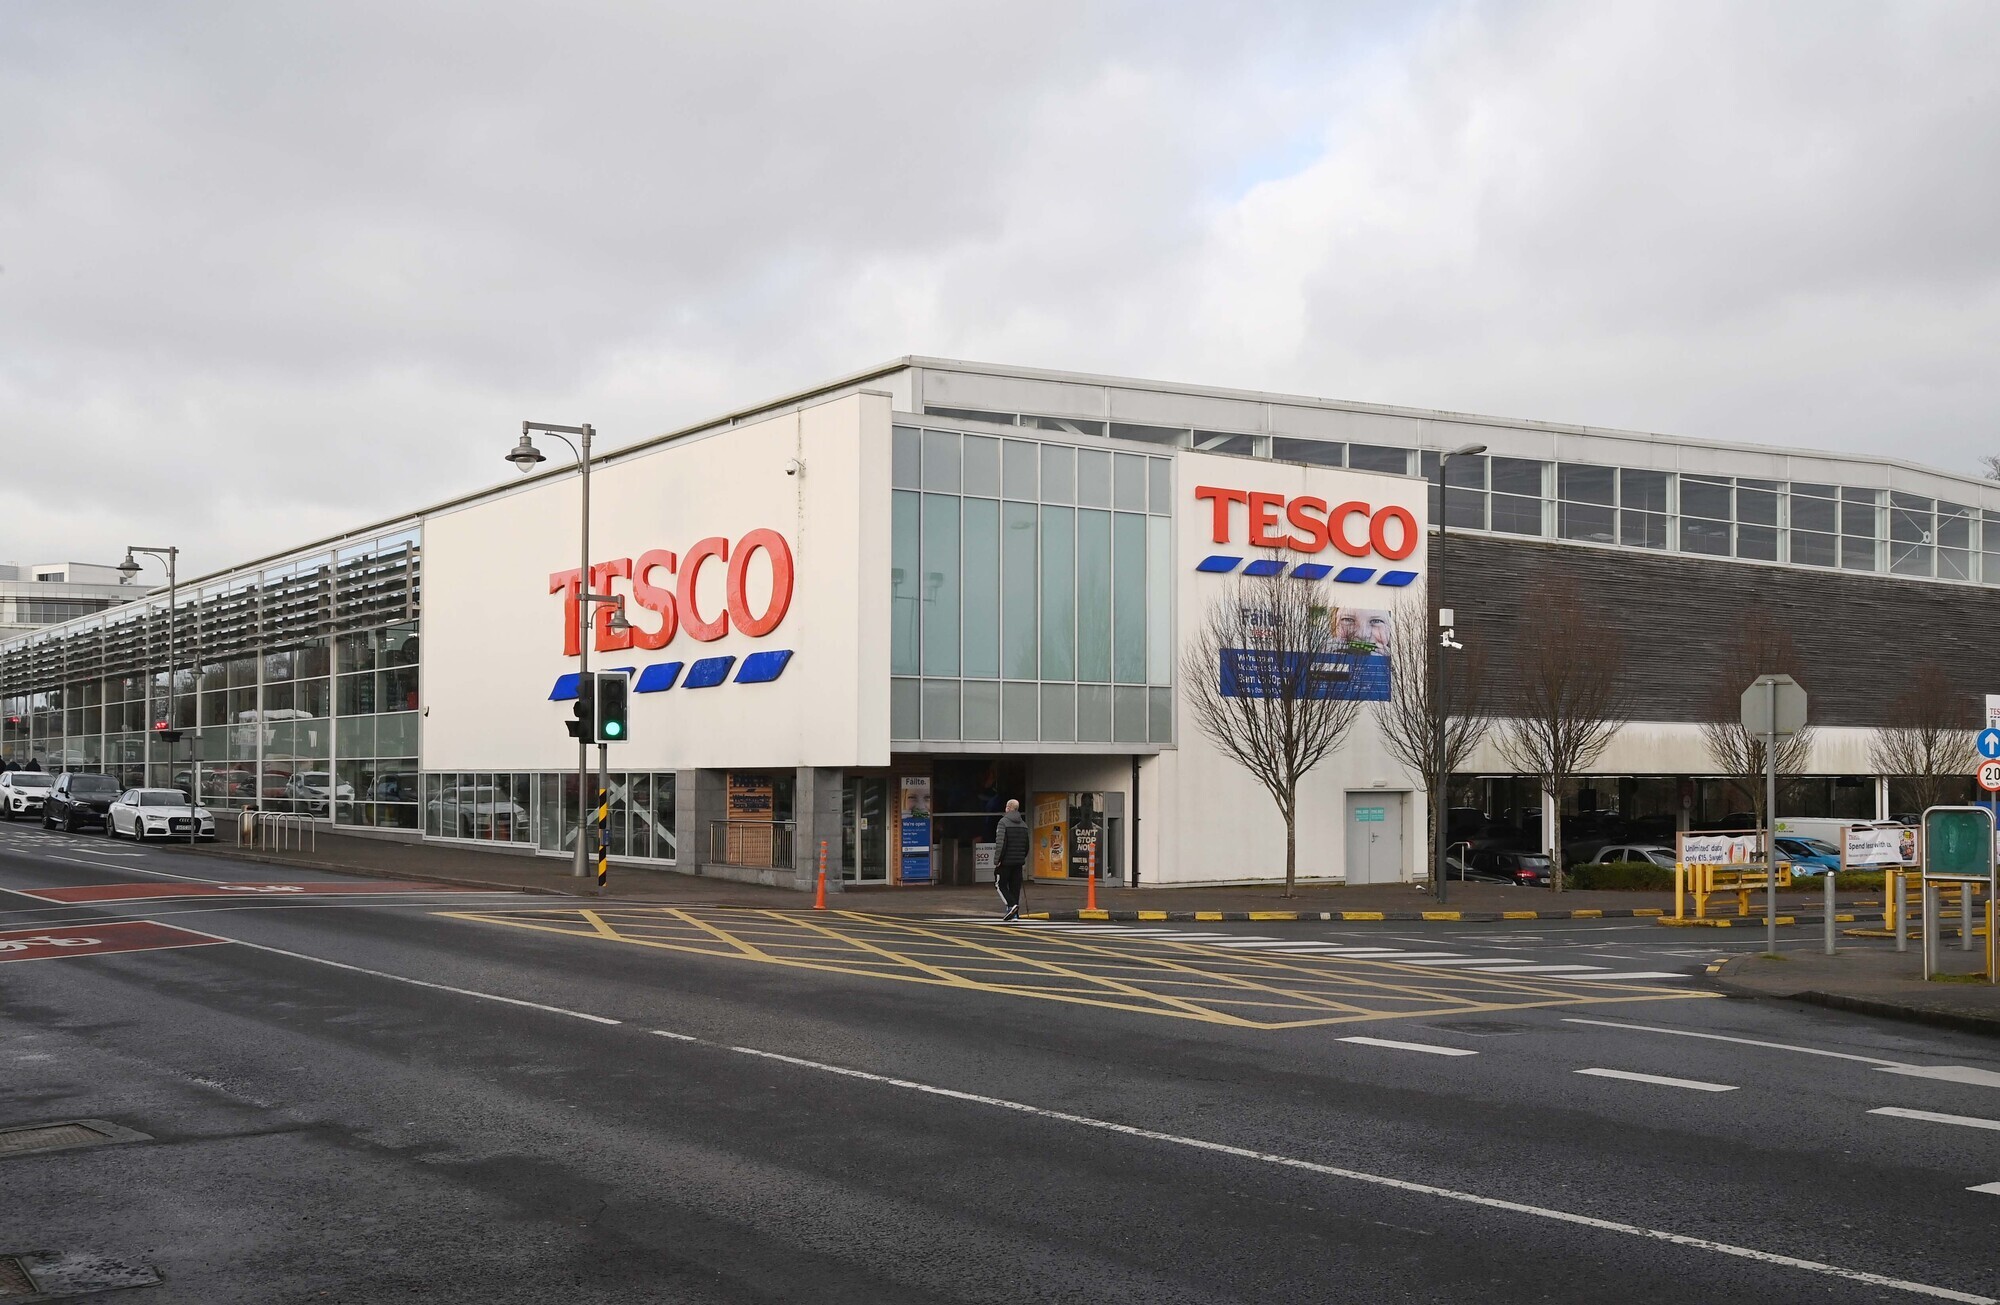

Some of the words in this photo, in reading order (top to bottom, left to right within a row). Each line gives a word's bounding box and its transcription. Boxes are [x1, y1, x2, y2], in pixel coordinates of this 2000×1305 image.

[1195, 485, 1419, 560] TESCO
[549, 527, 794, 657] TESCO
[1985, 767, 2000, 780] 20
[1075, 829, 1098, 837] CAN'T
[1076, 836, 1097, 844] STOP
[1849, 842, 1865, 851] Spend
[1685, 854, 1698, 863] only
